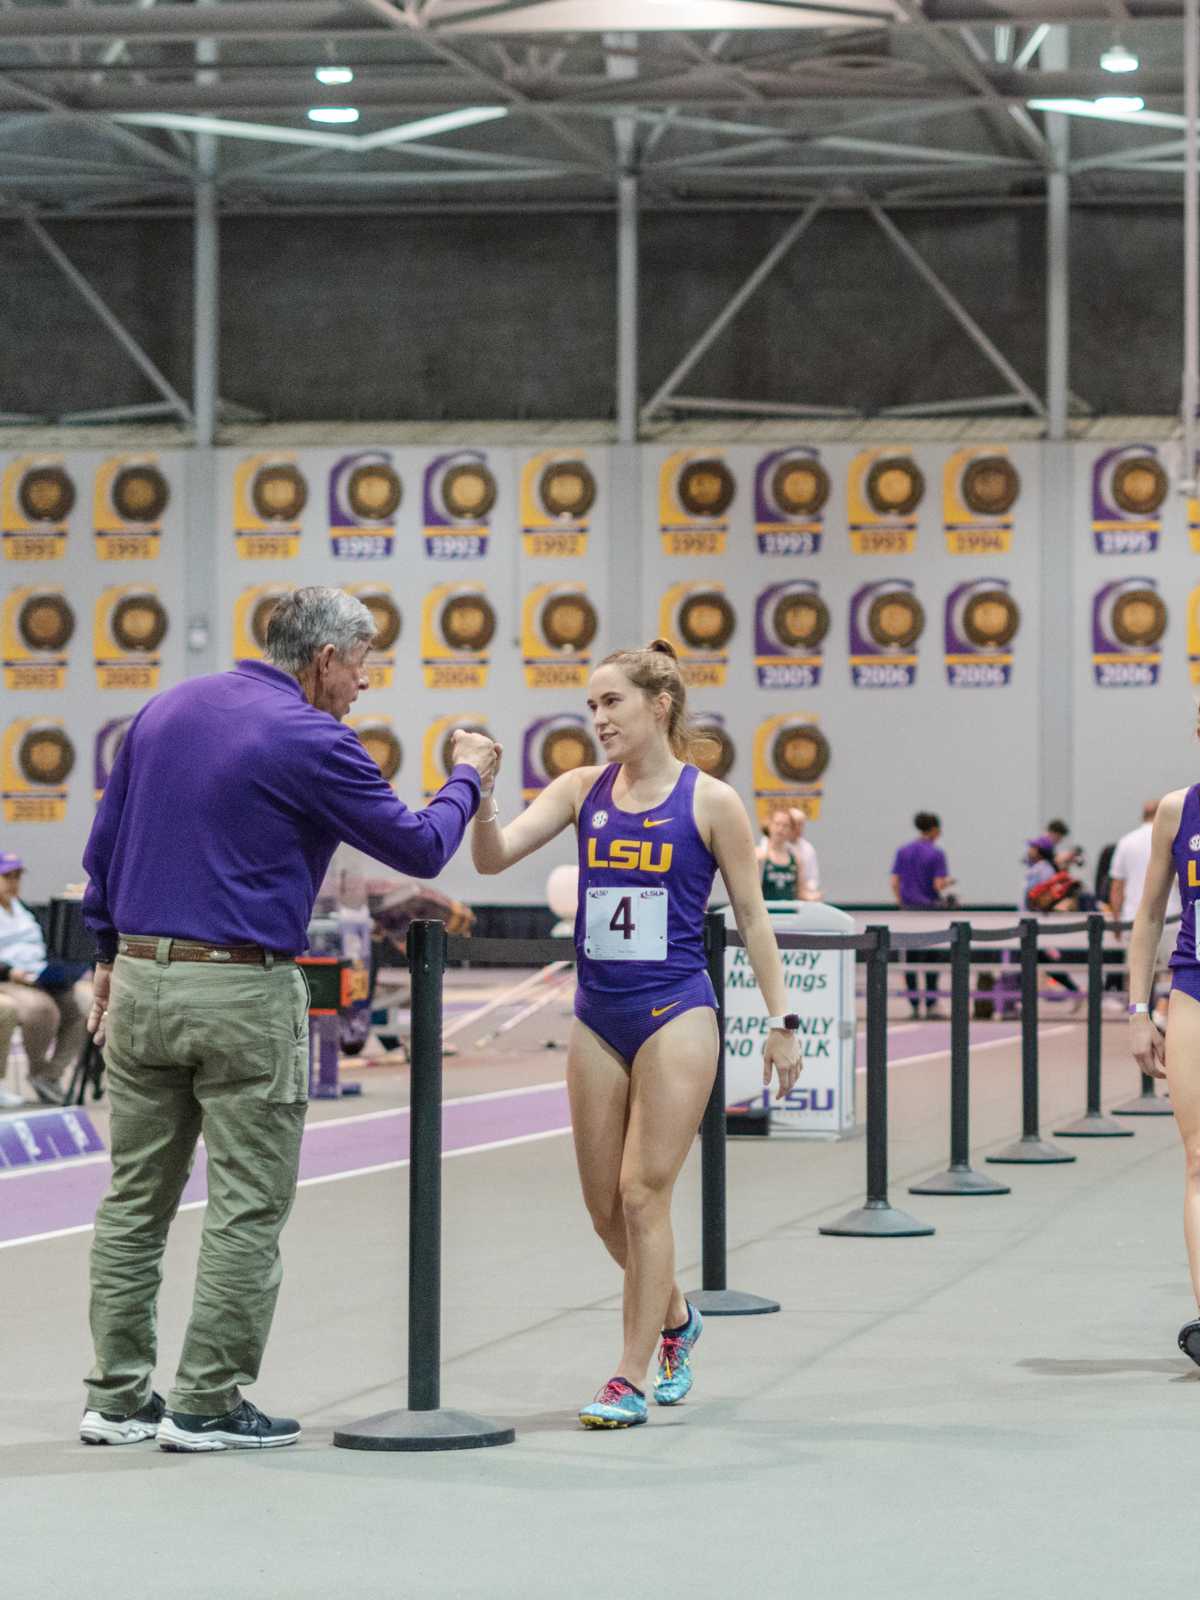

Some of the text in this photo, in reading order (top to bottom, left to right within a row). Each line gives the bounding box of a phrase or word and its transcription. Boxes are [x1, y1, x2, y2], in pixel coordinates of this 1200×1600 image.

[532, 536, 577, 554] 1992
[672, 533, 717, 552] 1992
[763, 534, 815, 552] 1993
[861, 533, 907, 551] 1993
[957, 533, 1004, 550] 1994
[1103, 533, 1151, 551] 1995
[433, 667, 480, 685] 2004
[534, 667, 581, 685] 2004
[1103, 666, 1151, 685] 2006
[588, 837, 673, 873] LSU
[609, 896, 636, 940] 4
[796, 1016, 834, 1034] NLY
[725, 1039, 753, 1057] NO
[763, 1088, 834, 1111] LSU
